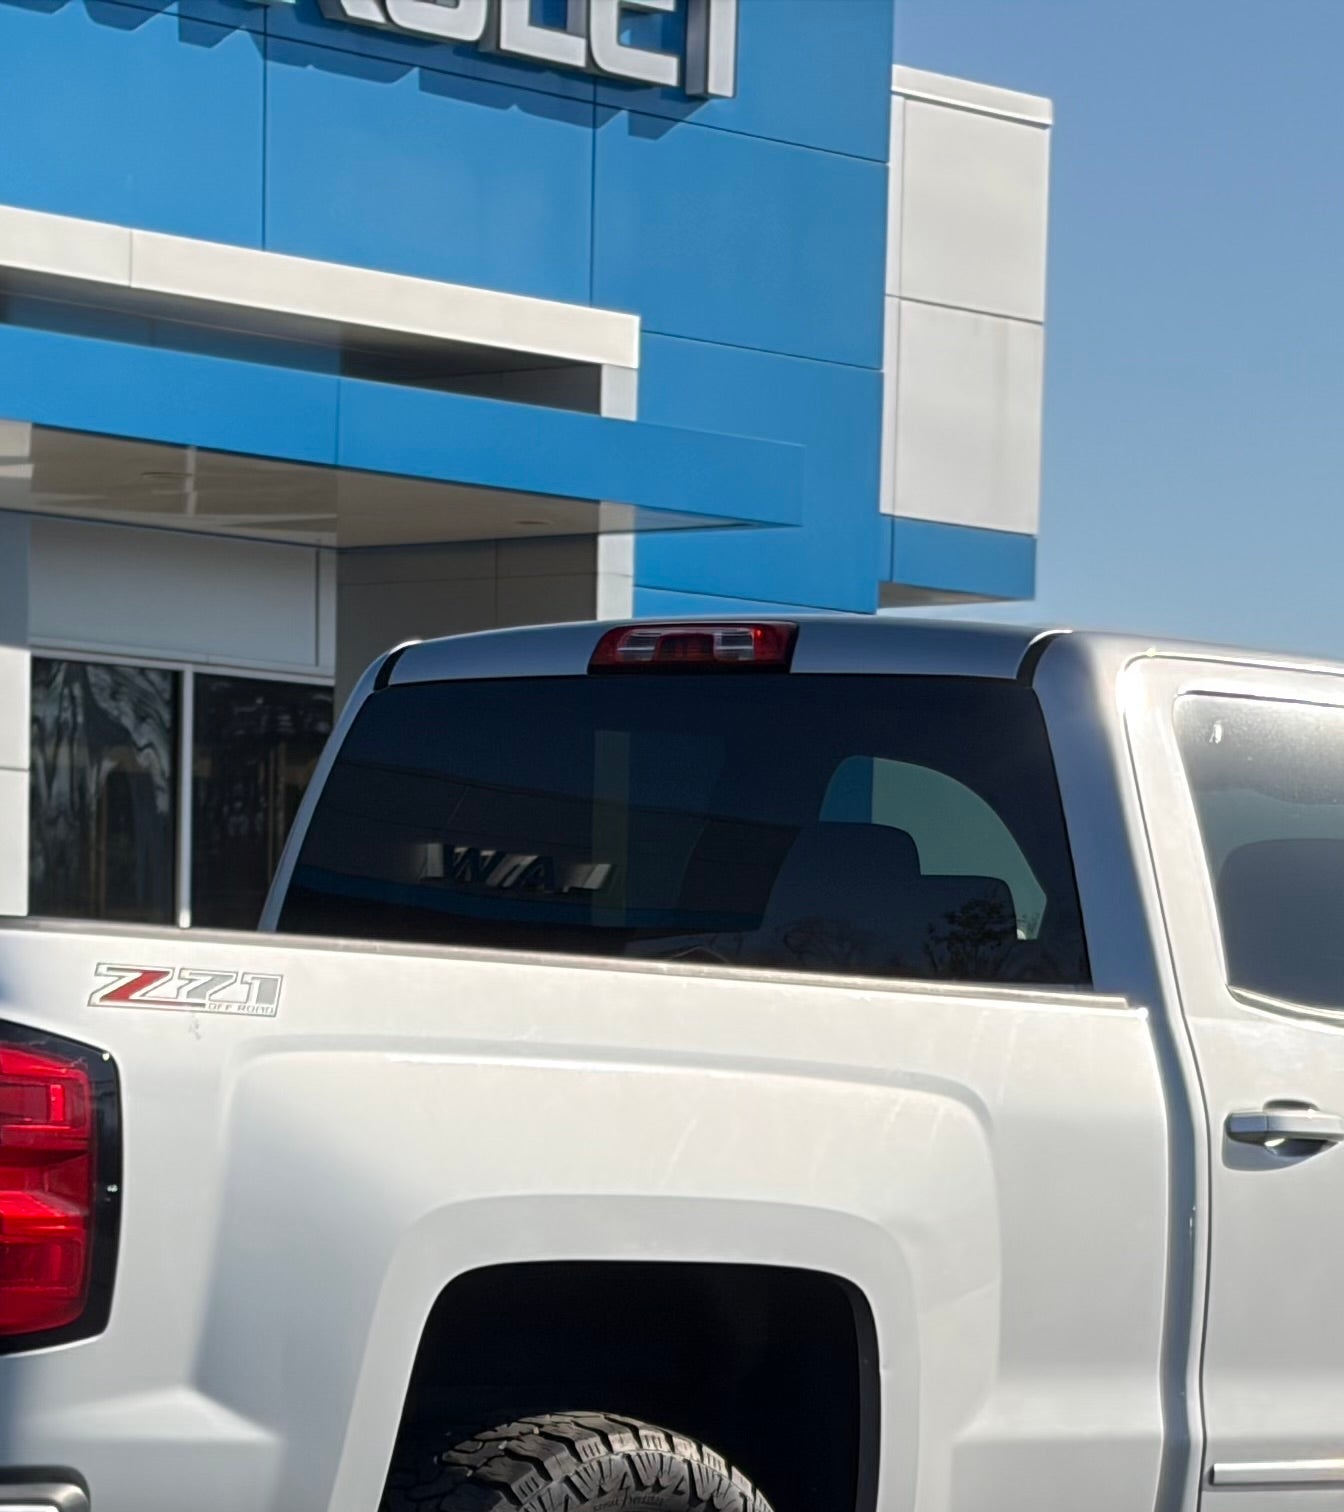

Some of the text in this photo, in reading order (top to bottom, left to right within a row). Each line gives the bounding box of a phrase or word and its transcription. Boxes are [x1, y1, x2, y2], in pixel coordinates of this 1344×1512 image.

[87, 962, 283, 1011] Z71
[207, 1003, 274, 1014] OFF ROAD
